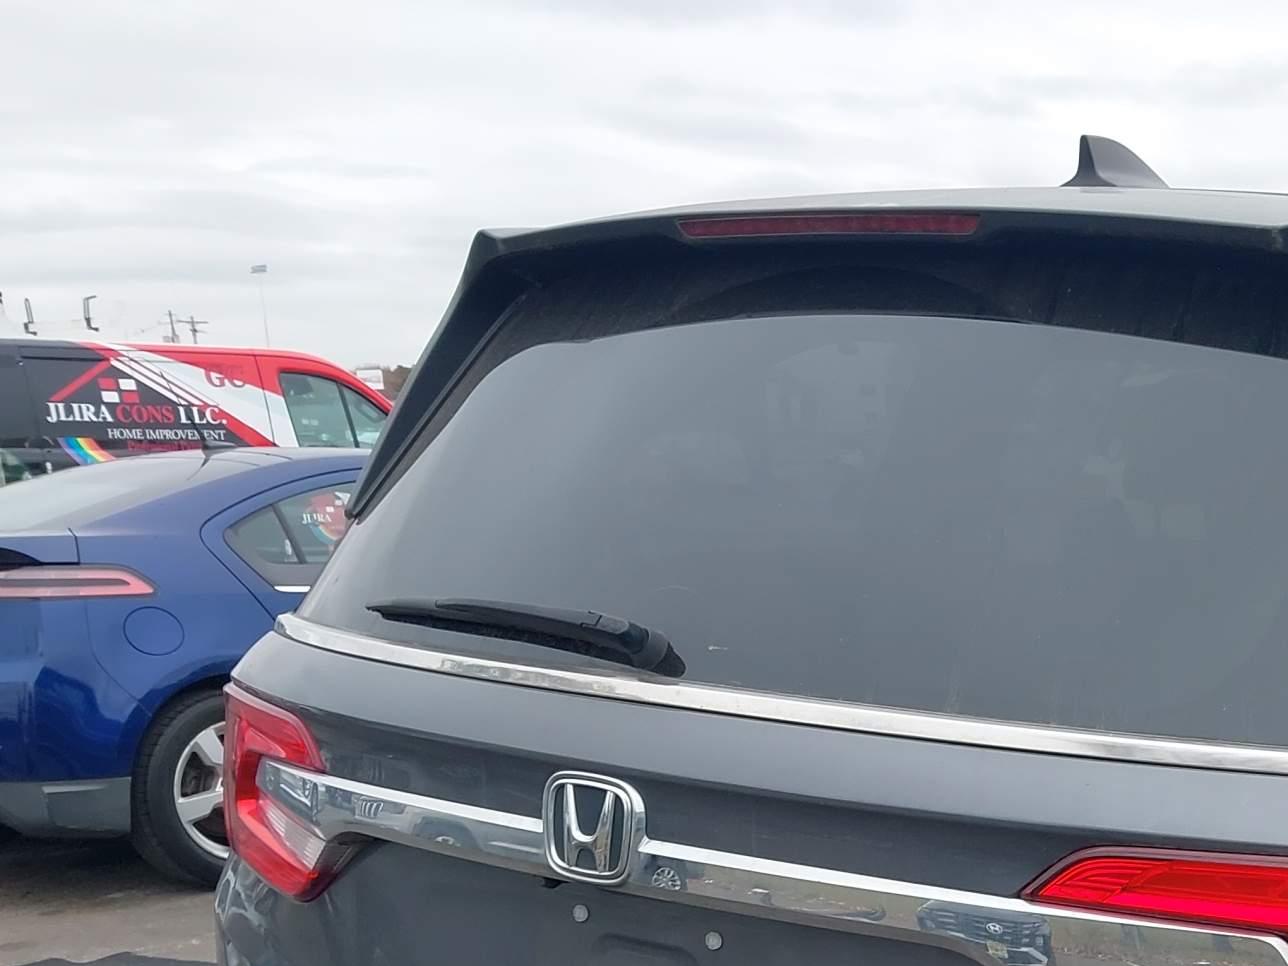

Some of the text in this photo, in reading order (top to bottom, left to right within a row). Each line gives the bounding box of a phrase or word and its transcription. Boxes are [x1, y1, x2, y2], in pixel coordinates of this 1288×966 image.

[46, 402, 228, 427] JLIRA CONS LLC.
[107, 427, 226, 442] HOME IMPROVEMENT
